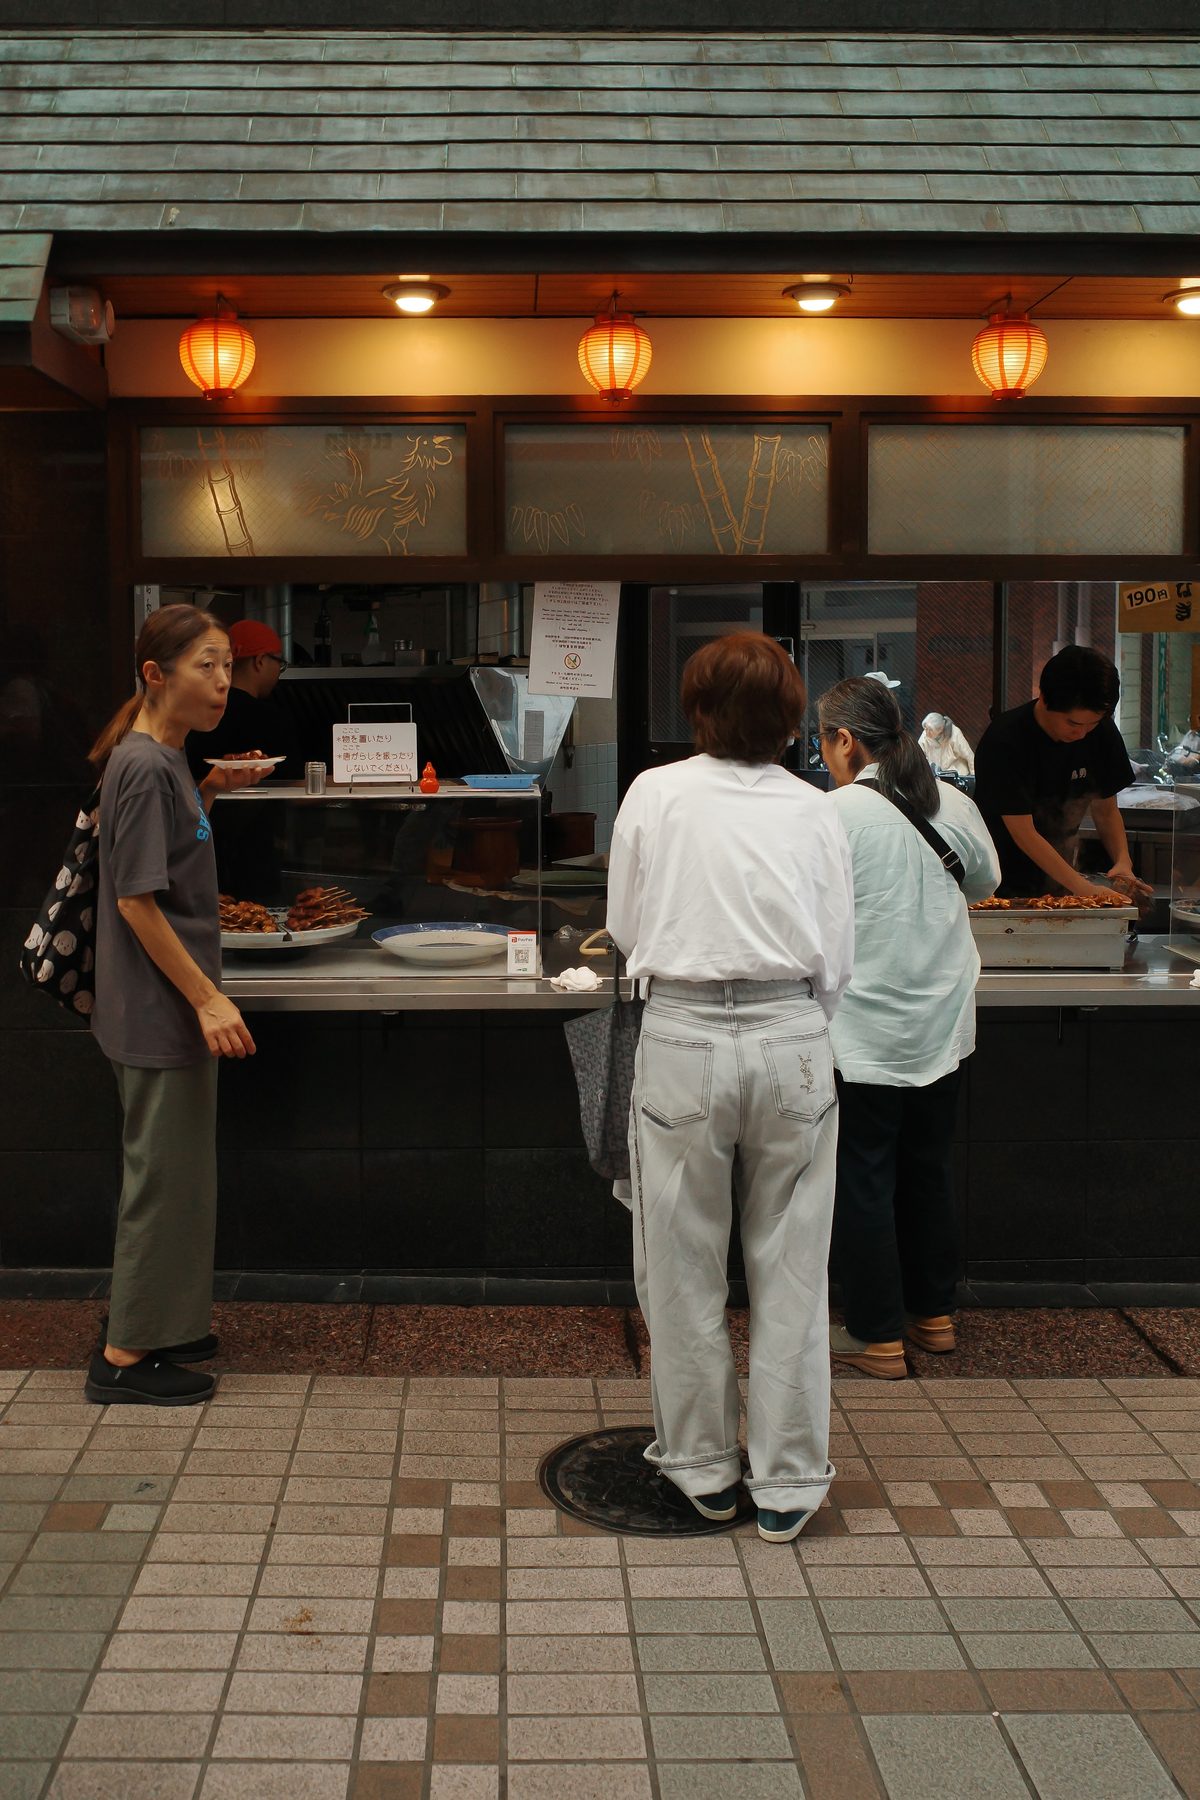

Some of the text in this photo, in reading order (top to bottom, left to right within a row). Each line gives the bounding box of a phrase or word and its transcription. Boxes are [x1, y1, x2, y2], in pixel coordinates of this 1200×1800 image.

[1126, 588, 1168, 608] 190円
[346, 763, 412, 773] しないでください。
